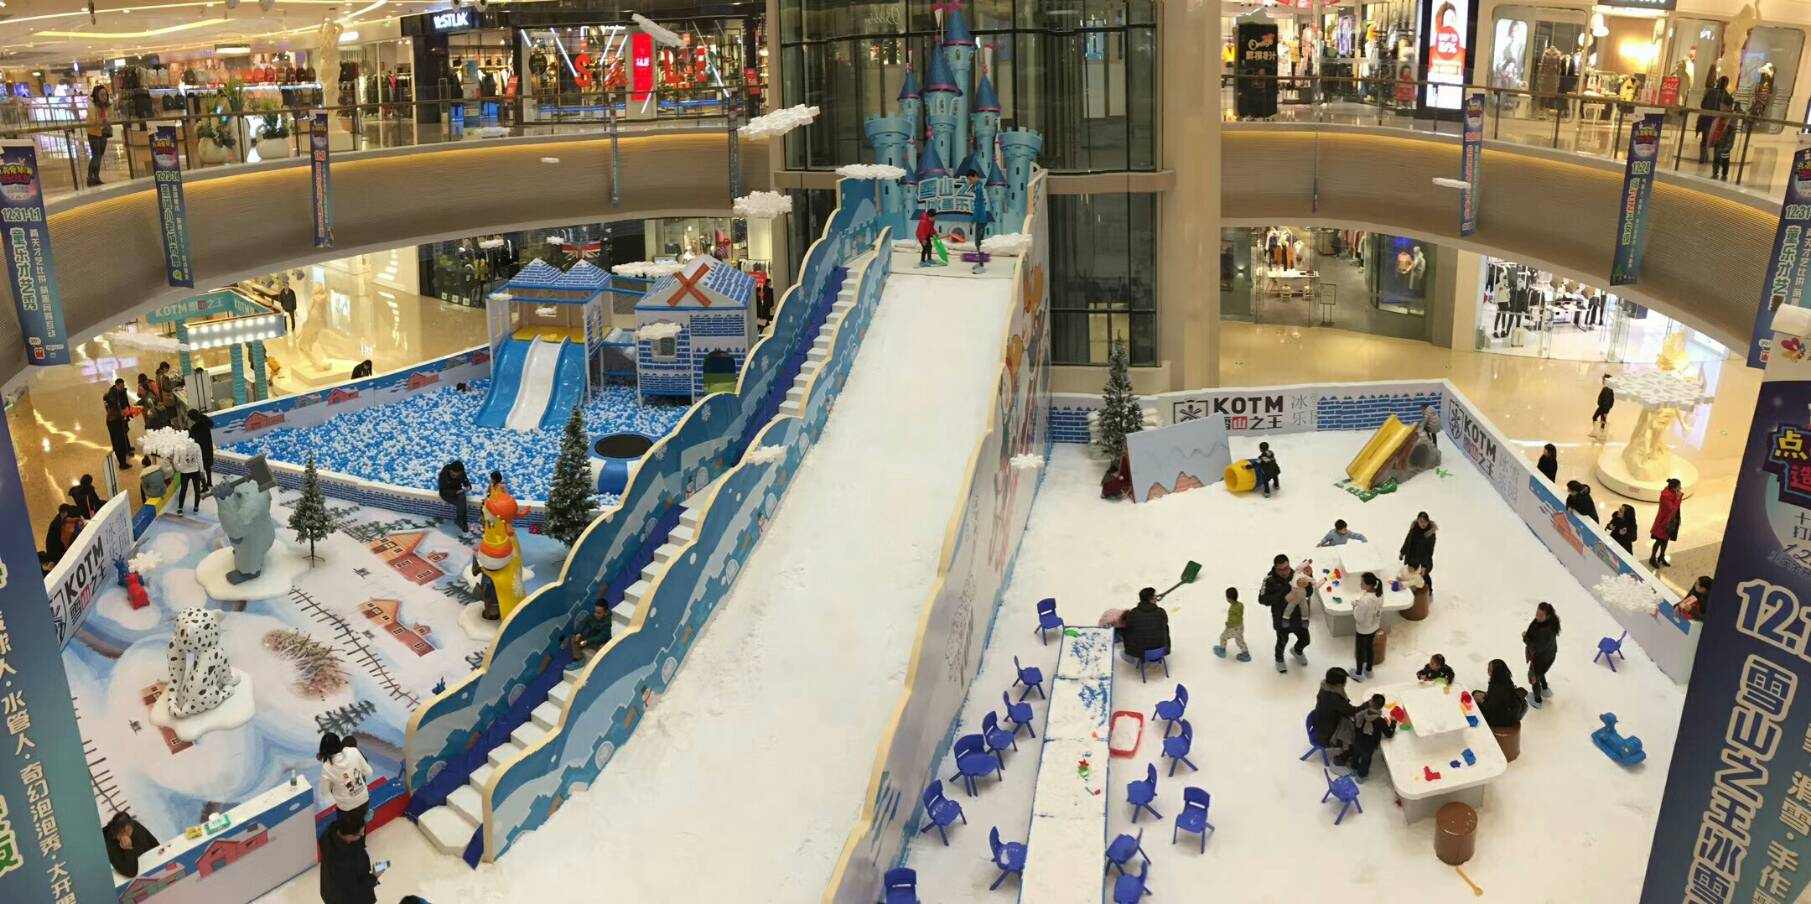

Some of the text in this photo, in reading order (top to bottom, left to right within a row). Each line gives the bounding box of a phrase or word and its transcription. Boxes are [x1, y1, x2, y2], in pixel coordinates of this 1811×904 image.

[1768, 225, 1802, 310] 童乐才艺
[155, 303, 188, 317] KOTM
[1213, 396, 1283, 414] KOTM
[1464, 415, 1497, 462] KOTM
[64, 536, 105, 605] KOTM
